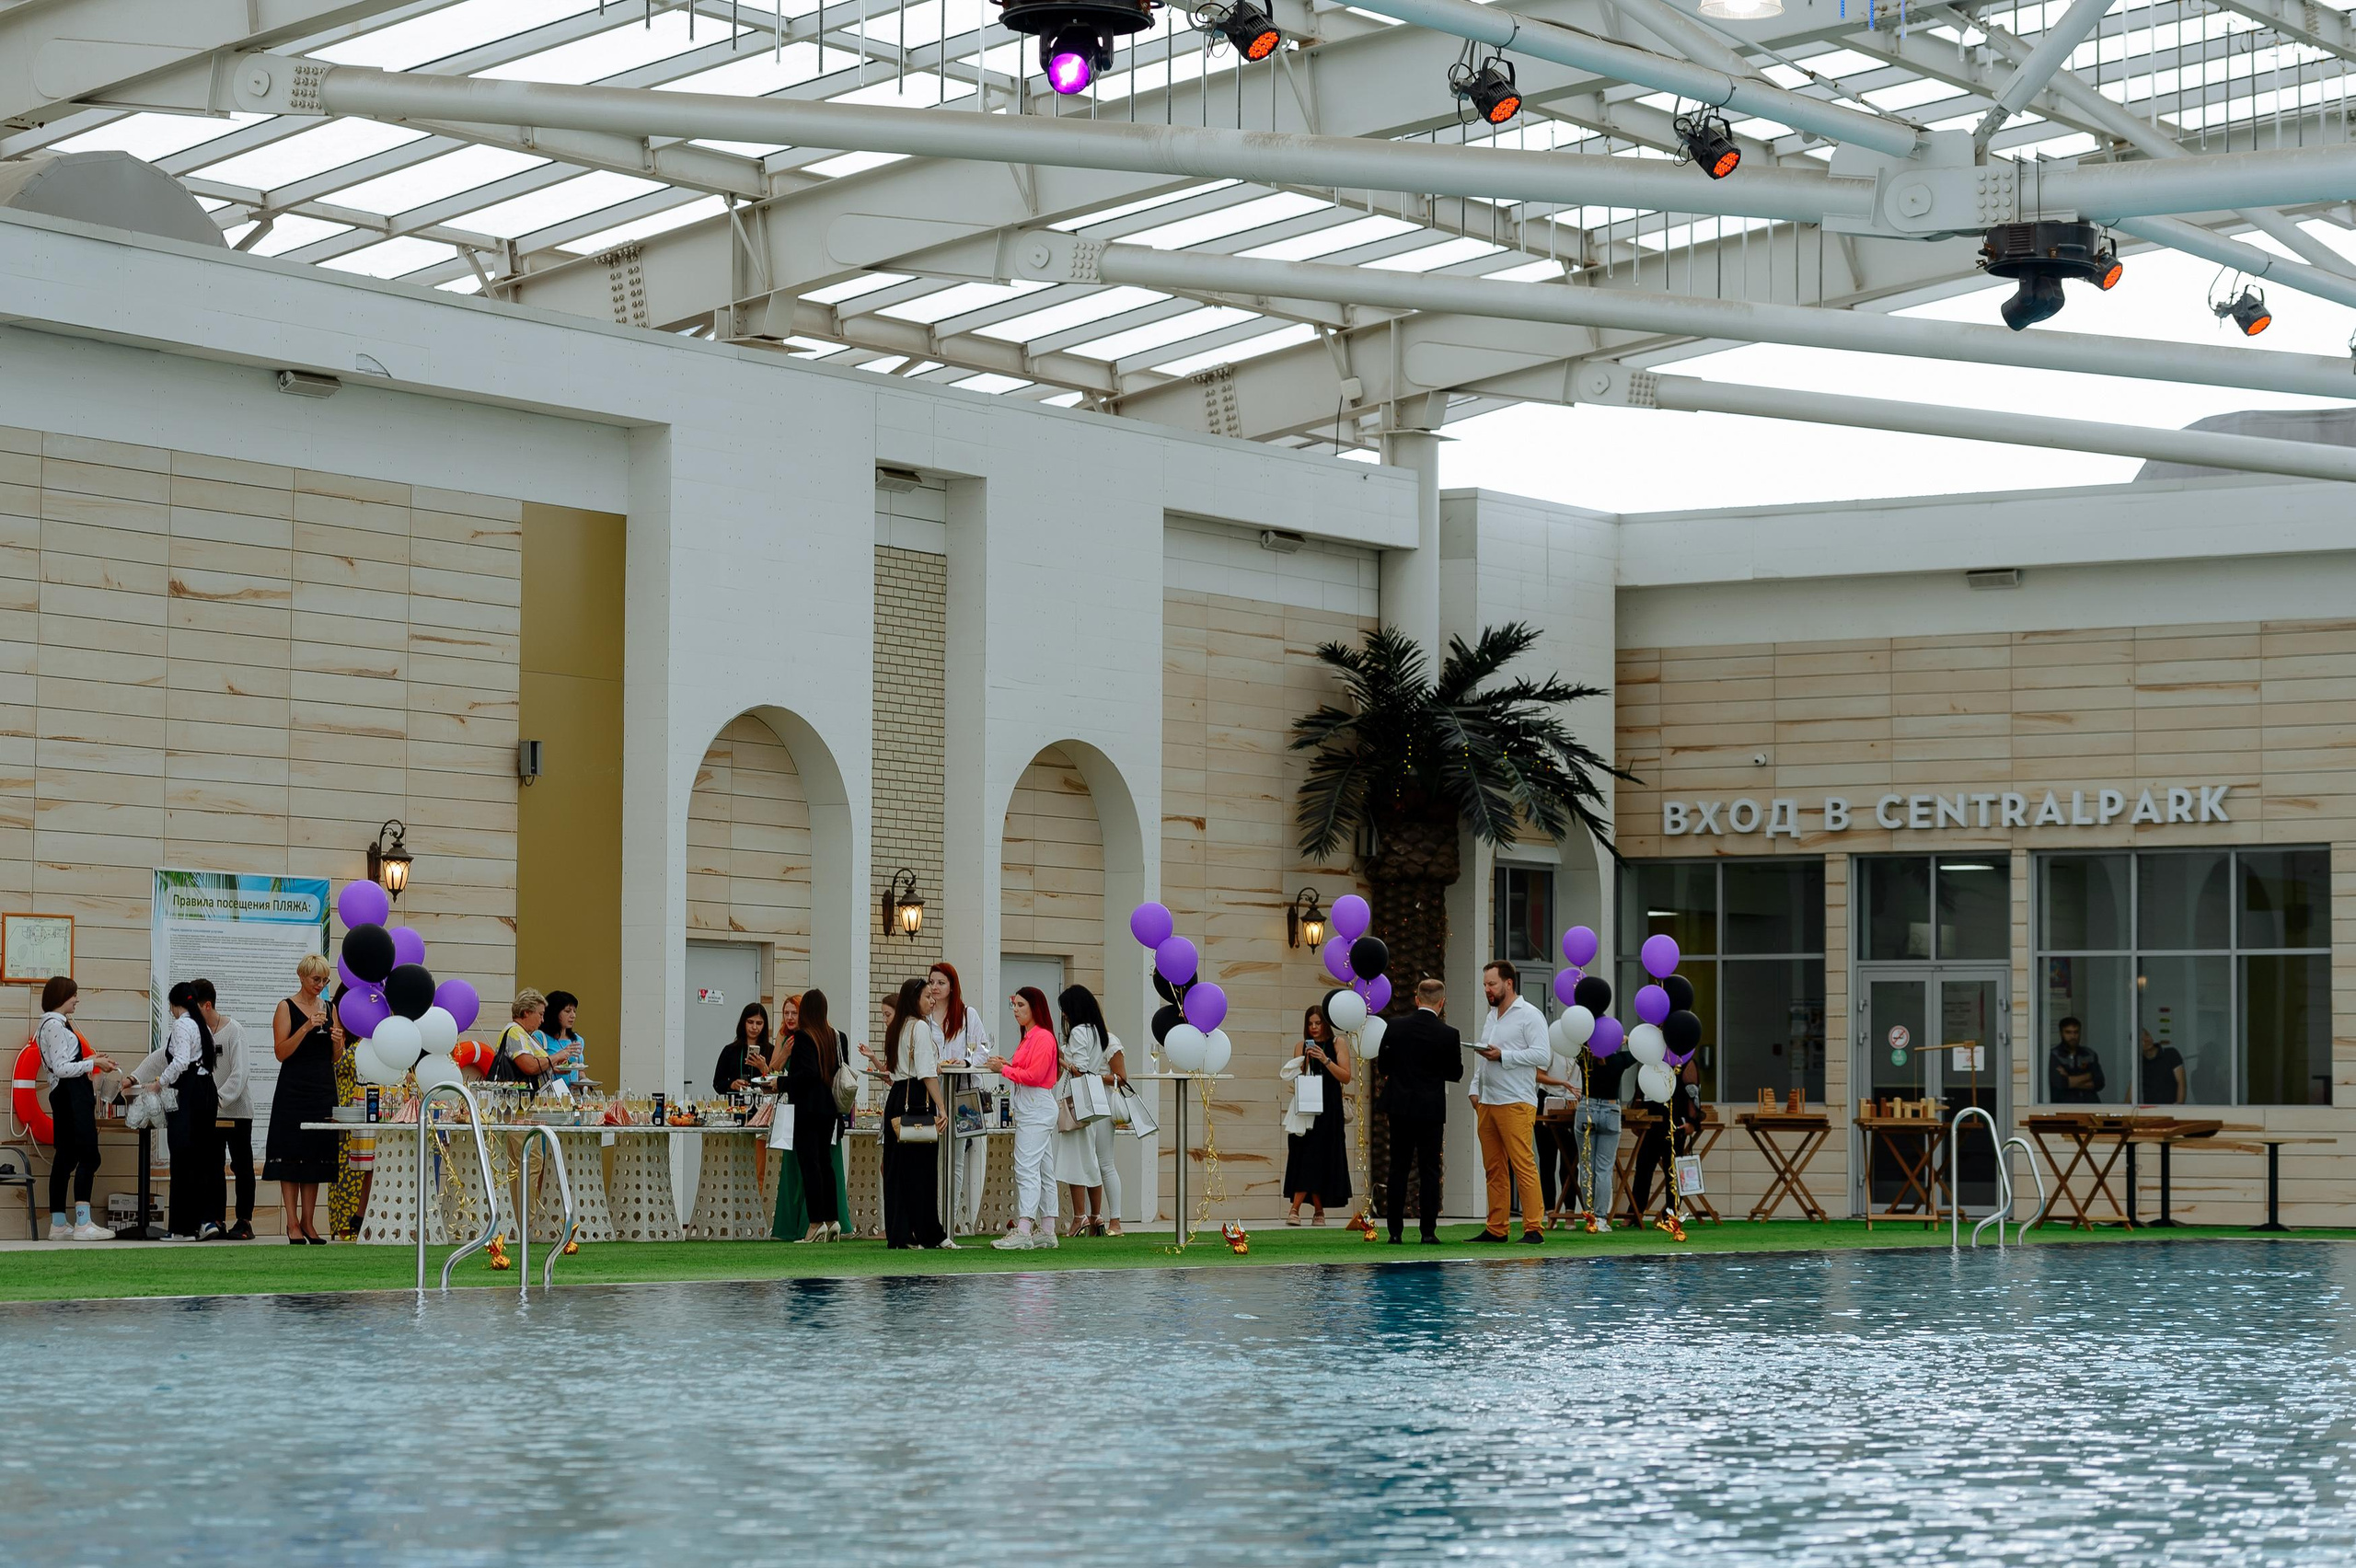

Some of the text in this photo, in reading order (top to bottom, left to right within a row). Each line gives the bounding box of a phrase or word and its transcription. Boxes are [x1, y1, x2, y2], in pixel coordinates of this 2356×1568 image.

[1663, 785, 2231, 839] ВХОД В CENTRALPARK
[172, 894, 311, 913] Правила посещения ПЛЯЖА:
